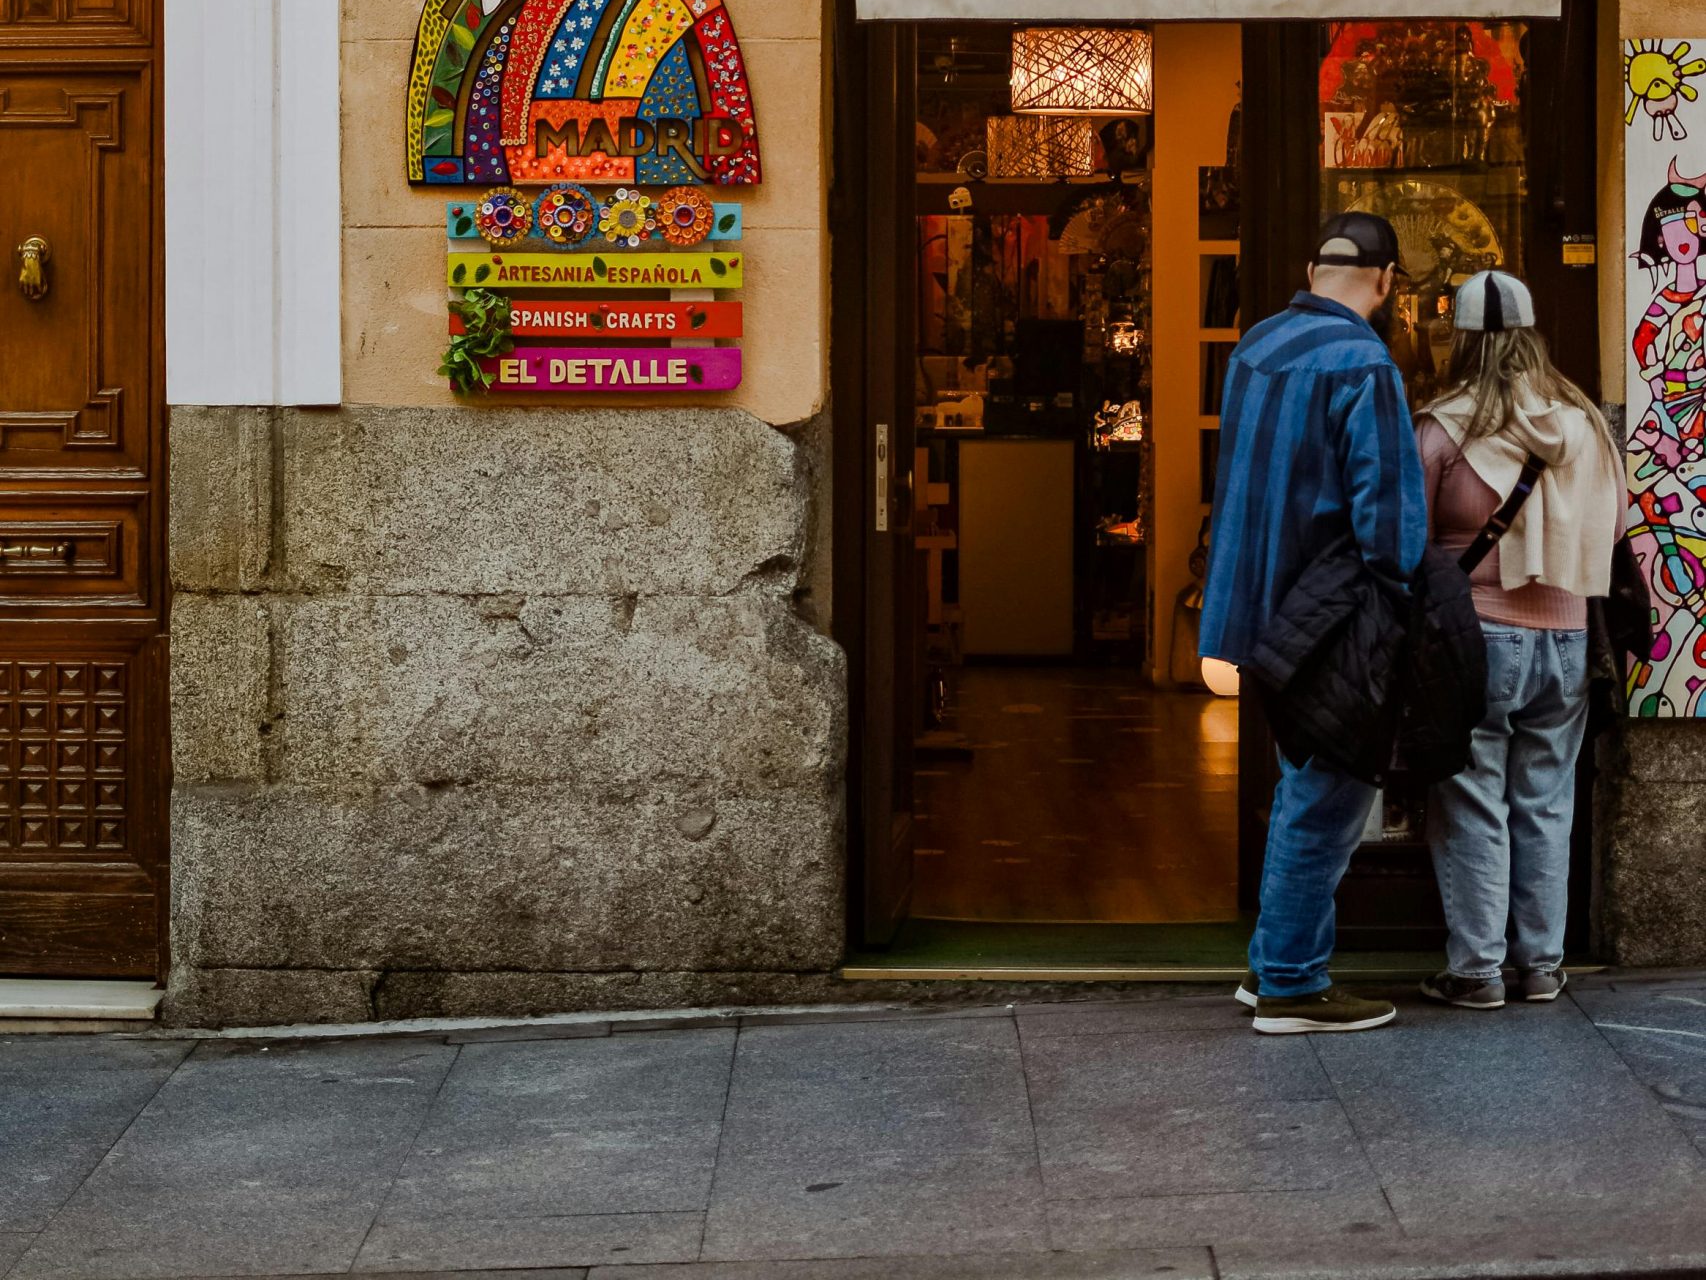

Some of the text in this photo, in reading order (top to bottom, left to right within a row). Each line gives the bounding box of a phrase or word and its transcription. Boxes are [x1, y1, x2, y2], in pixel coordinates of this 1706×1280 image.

[535, 117, 744, 180] MADRID
[497, 263, 702, 284] ARTESANIA ESPAÑOLA
[510, 310, 676, 329] SPANISH CRAFTS
[500, 359, 687, 385] EL DETALLE
